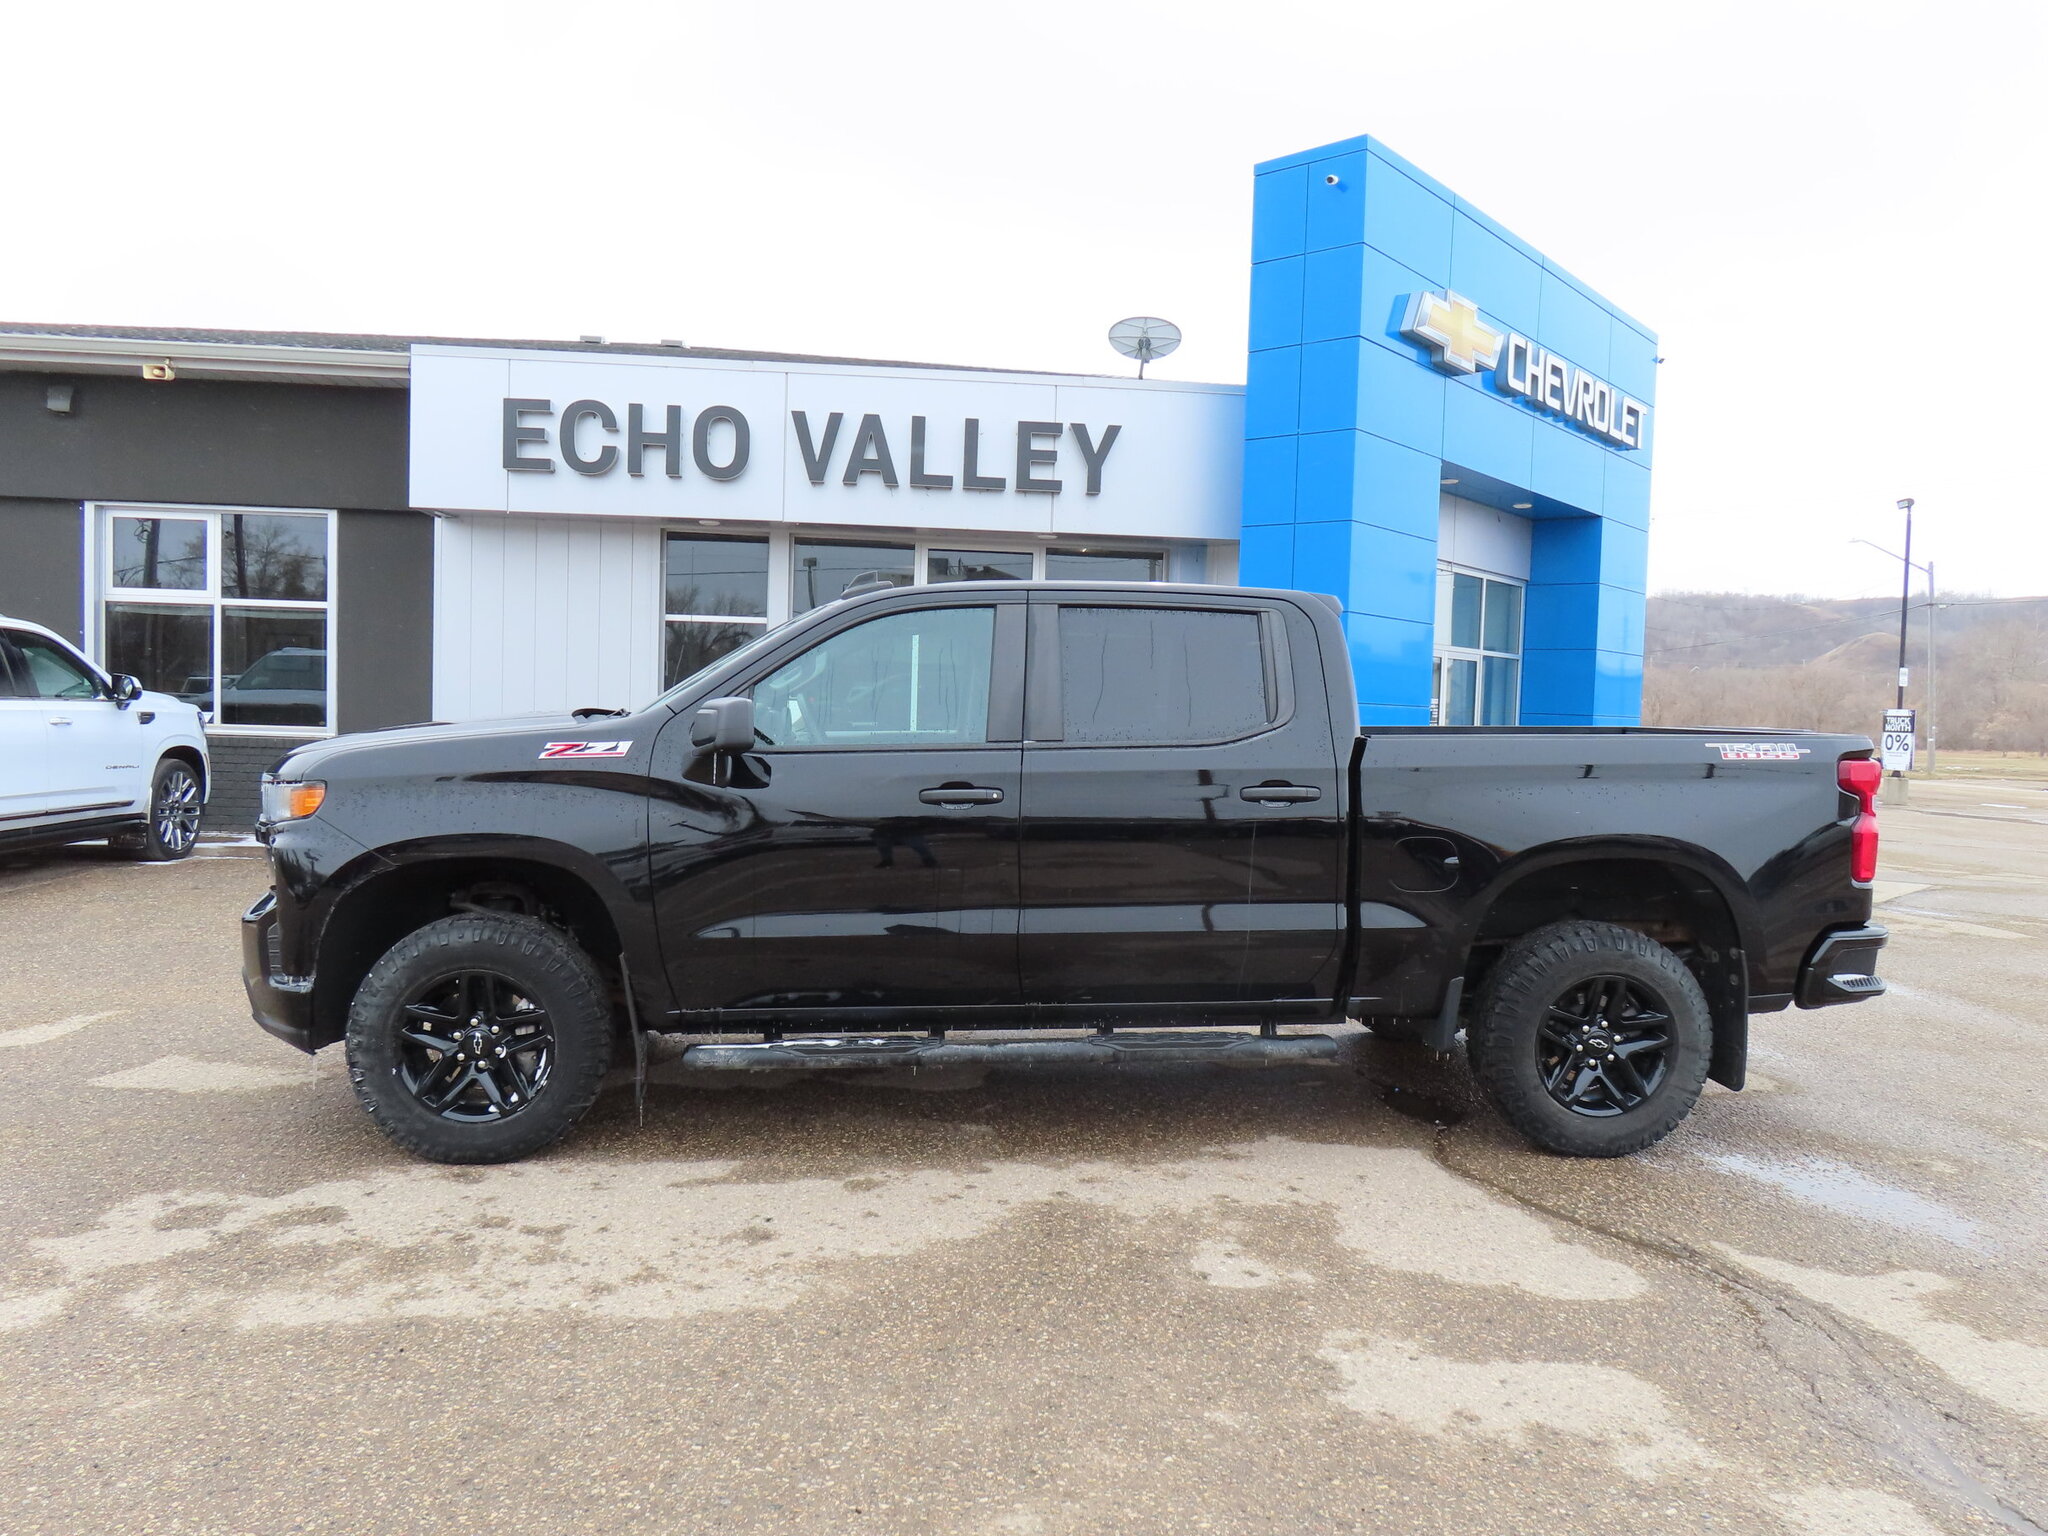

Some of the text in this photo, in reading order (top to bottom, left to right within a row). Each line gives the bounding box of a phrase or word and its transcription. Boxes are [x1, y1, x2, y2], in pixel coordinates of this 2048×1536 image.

[1506, 332, 1648, 449] CHEVROLET
[503, 397, 1122, 495] ECHO VALLEY
[1884, 724, 1911, 732] MONTH
[1885, 716, 1911, 725] TRUCK
[538, 741, 634, 760] Z71
[1885, 734, 1910, 751] 0%
